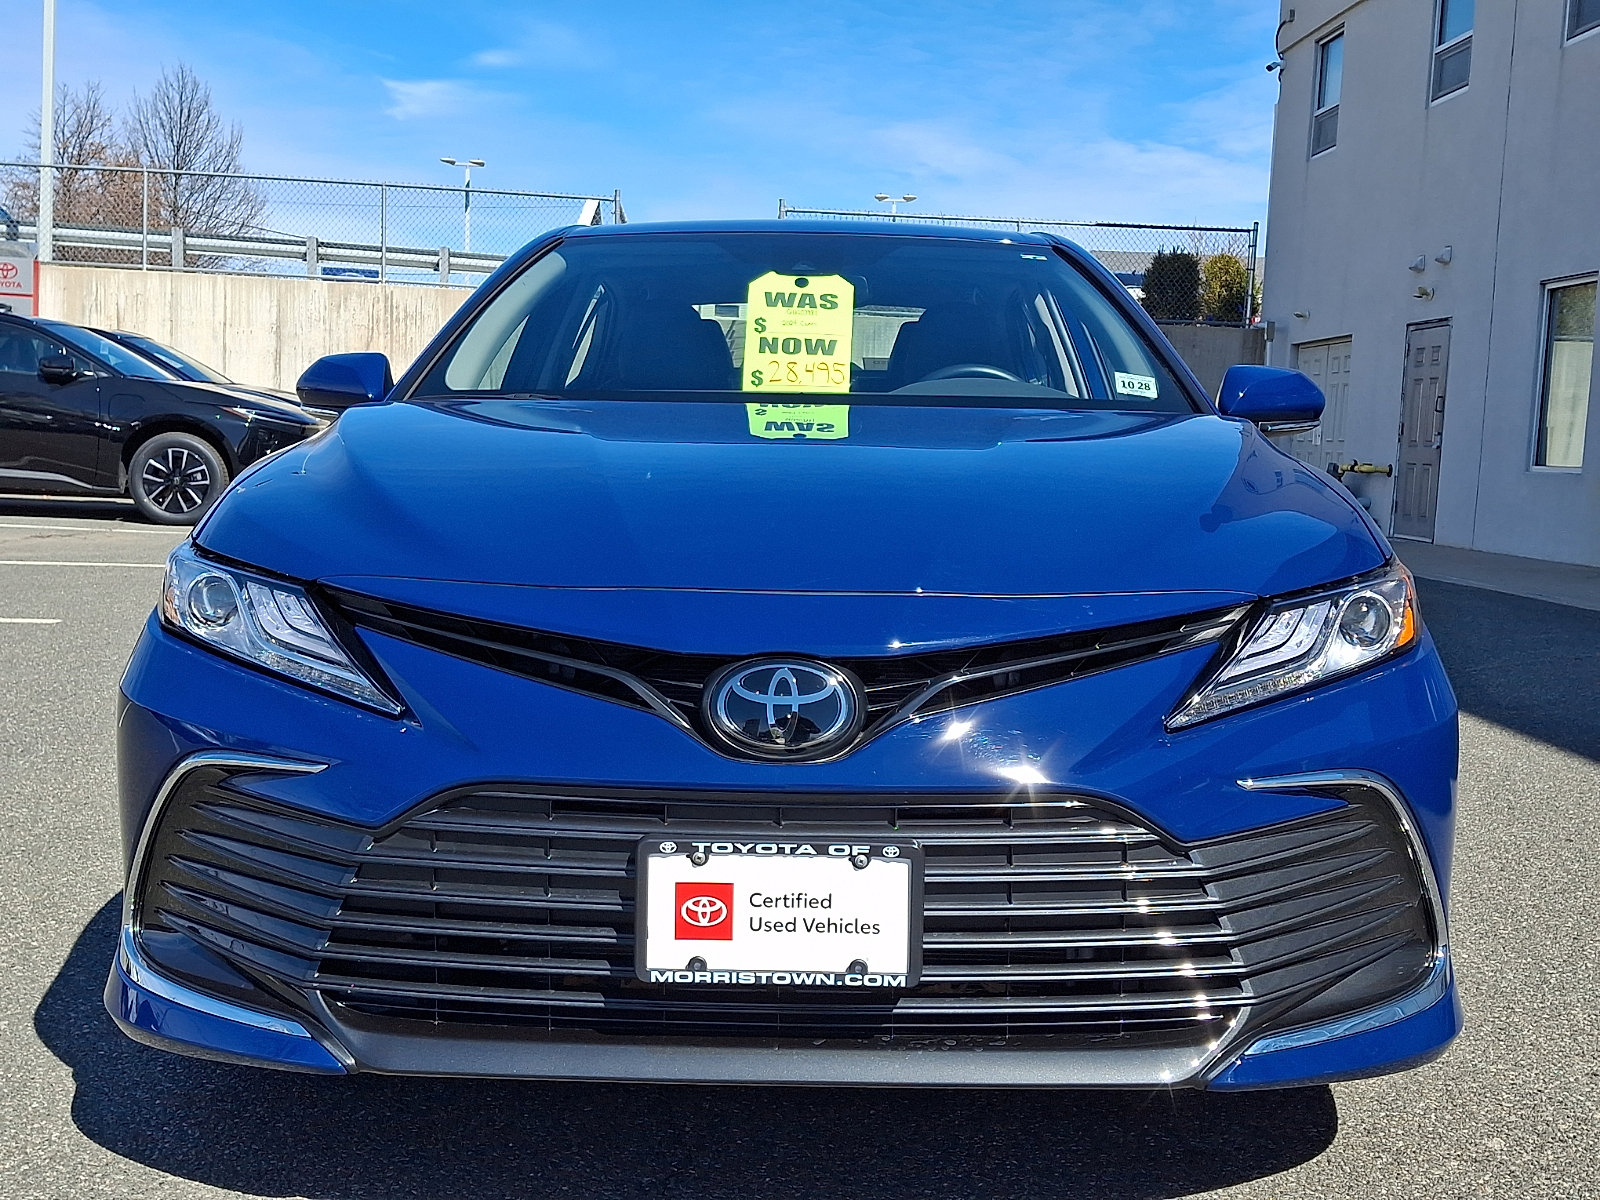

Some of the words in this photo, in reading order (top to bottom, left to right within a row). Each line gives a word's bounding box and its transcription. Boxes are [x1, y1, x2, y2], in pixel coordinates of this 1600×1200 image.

[0, 280, 23, 288] YOTA
[764, 291, 839, 310] WAS
[754, 317, 767, 334] $
[758, 336, 838, 356] NOW
[1120, 380, 1135, 389] 10
[1137, 382, 1151, 391] 28
[691, 842, 818, 856] TOYOTA
[828, 844, 872, 856] OF
[749, 892, 833, 909] Certified
[749, 917, 797, 933] Used
[803, 917, 881, 935] Vehicles
[650, 970, 907, 988] MORRISTOWN.COM
